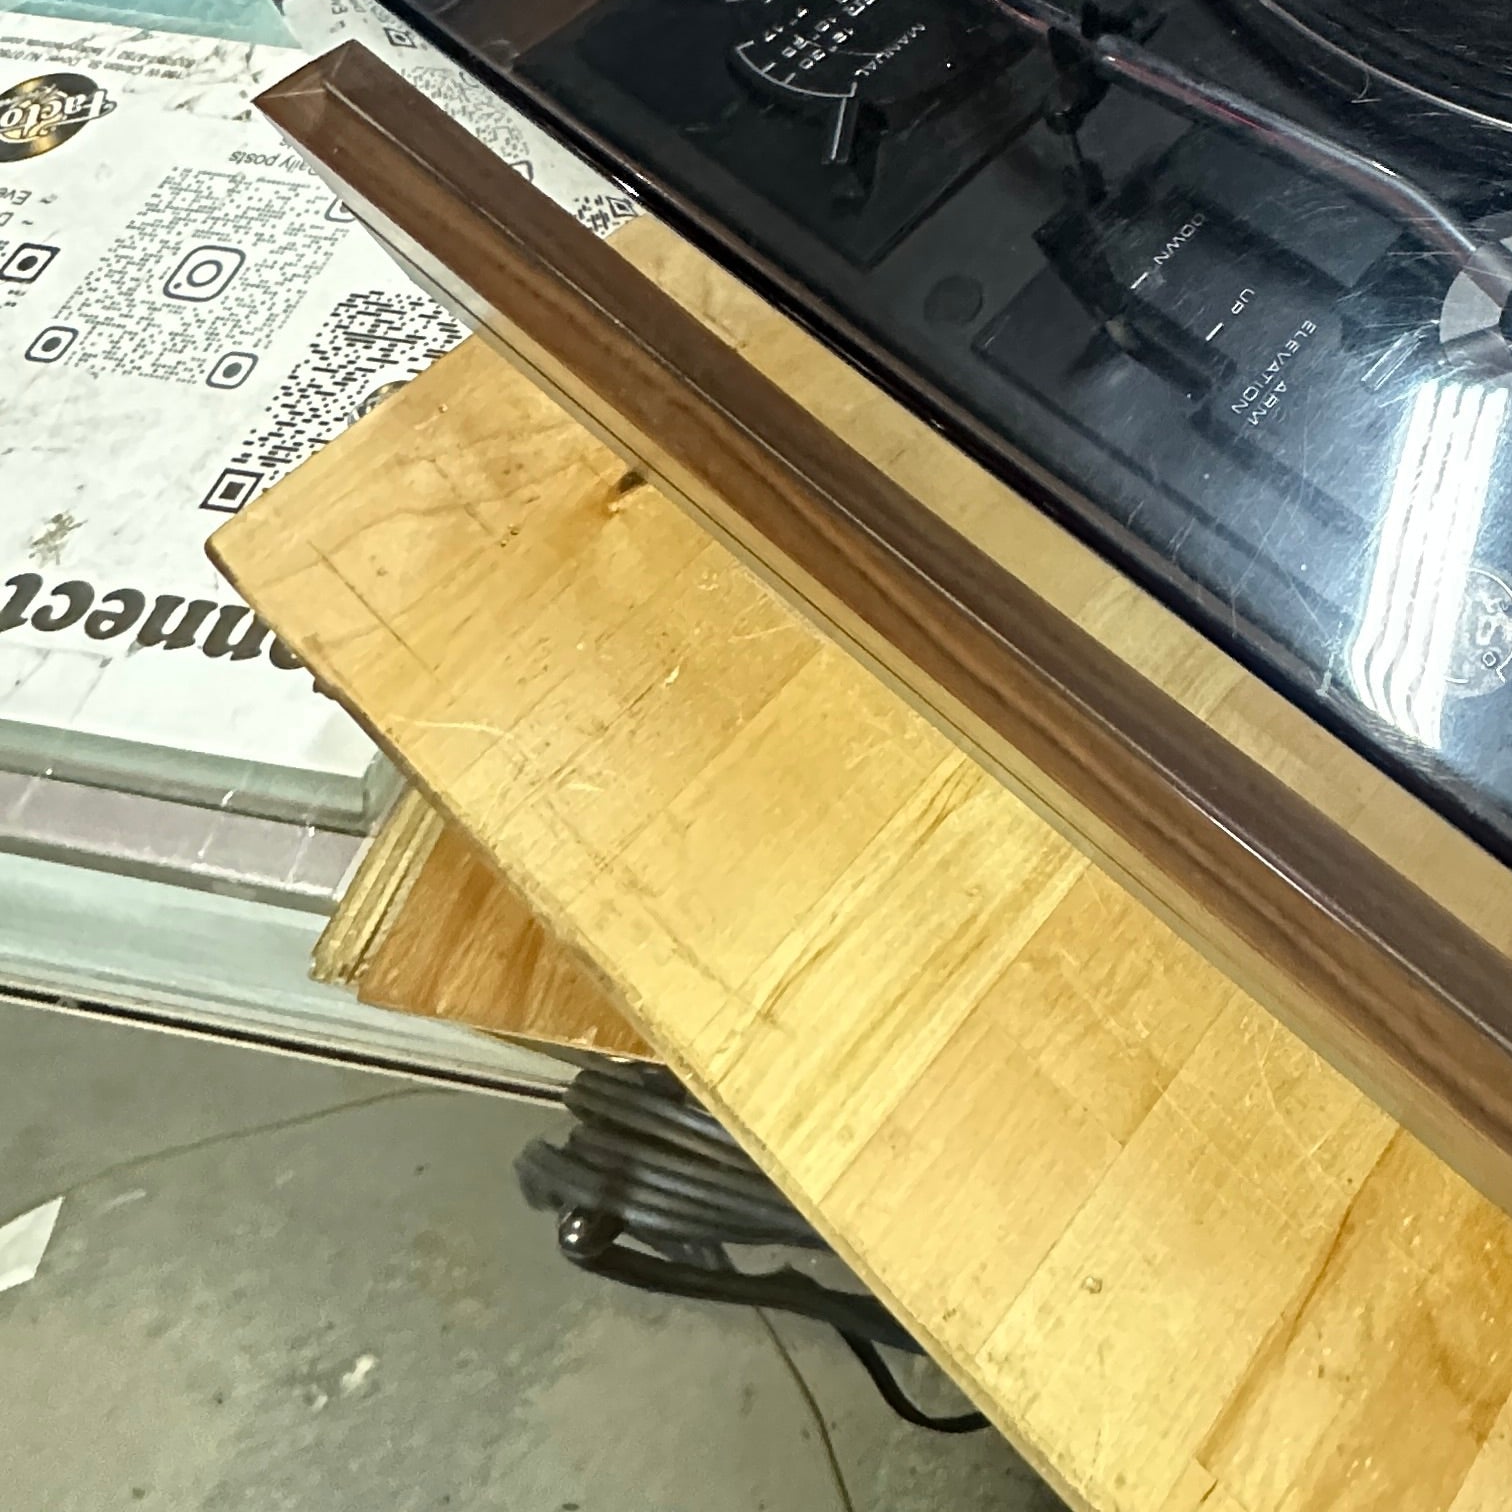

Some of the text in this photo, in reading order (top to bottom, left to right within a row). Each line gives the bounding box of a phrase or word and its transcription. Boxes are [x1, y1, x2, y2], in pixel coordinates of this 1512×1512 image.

[854, 23, 926, 77] MANUAL
[228, 150, 281, 166] posts
[1153, 212, 1205, 266] DOWN
[1230, 287, 1257, 316] UP
[1230, 319, 1318, 416] ELEVATION
[1247, 380, 1288, 426] ARM
